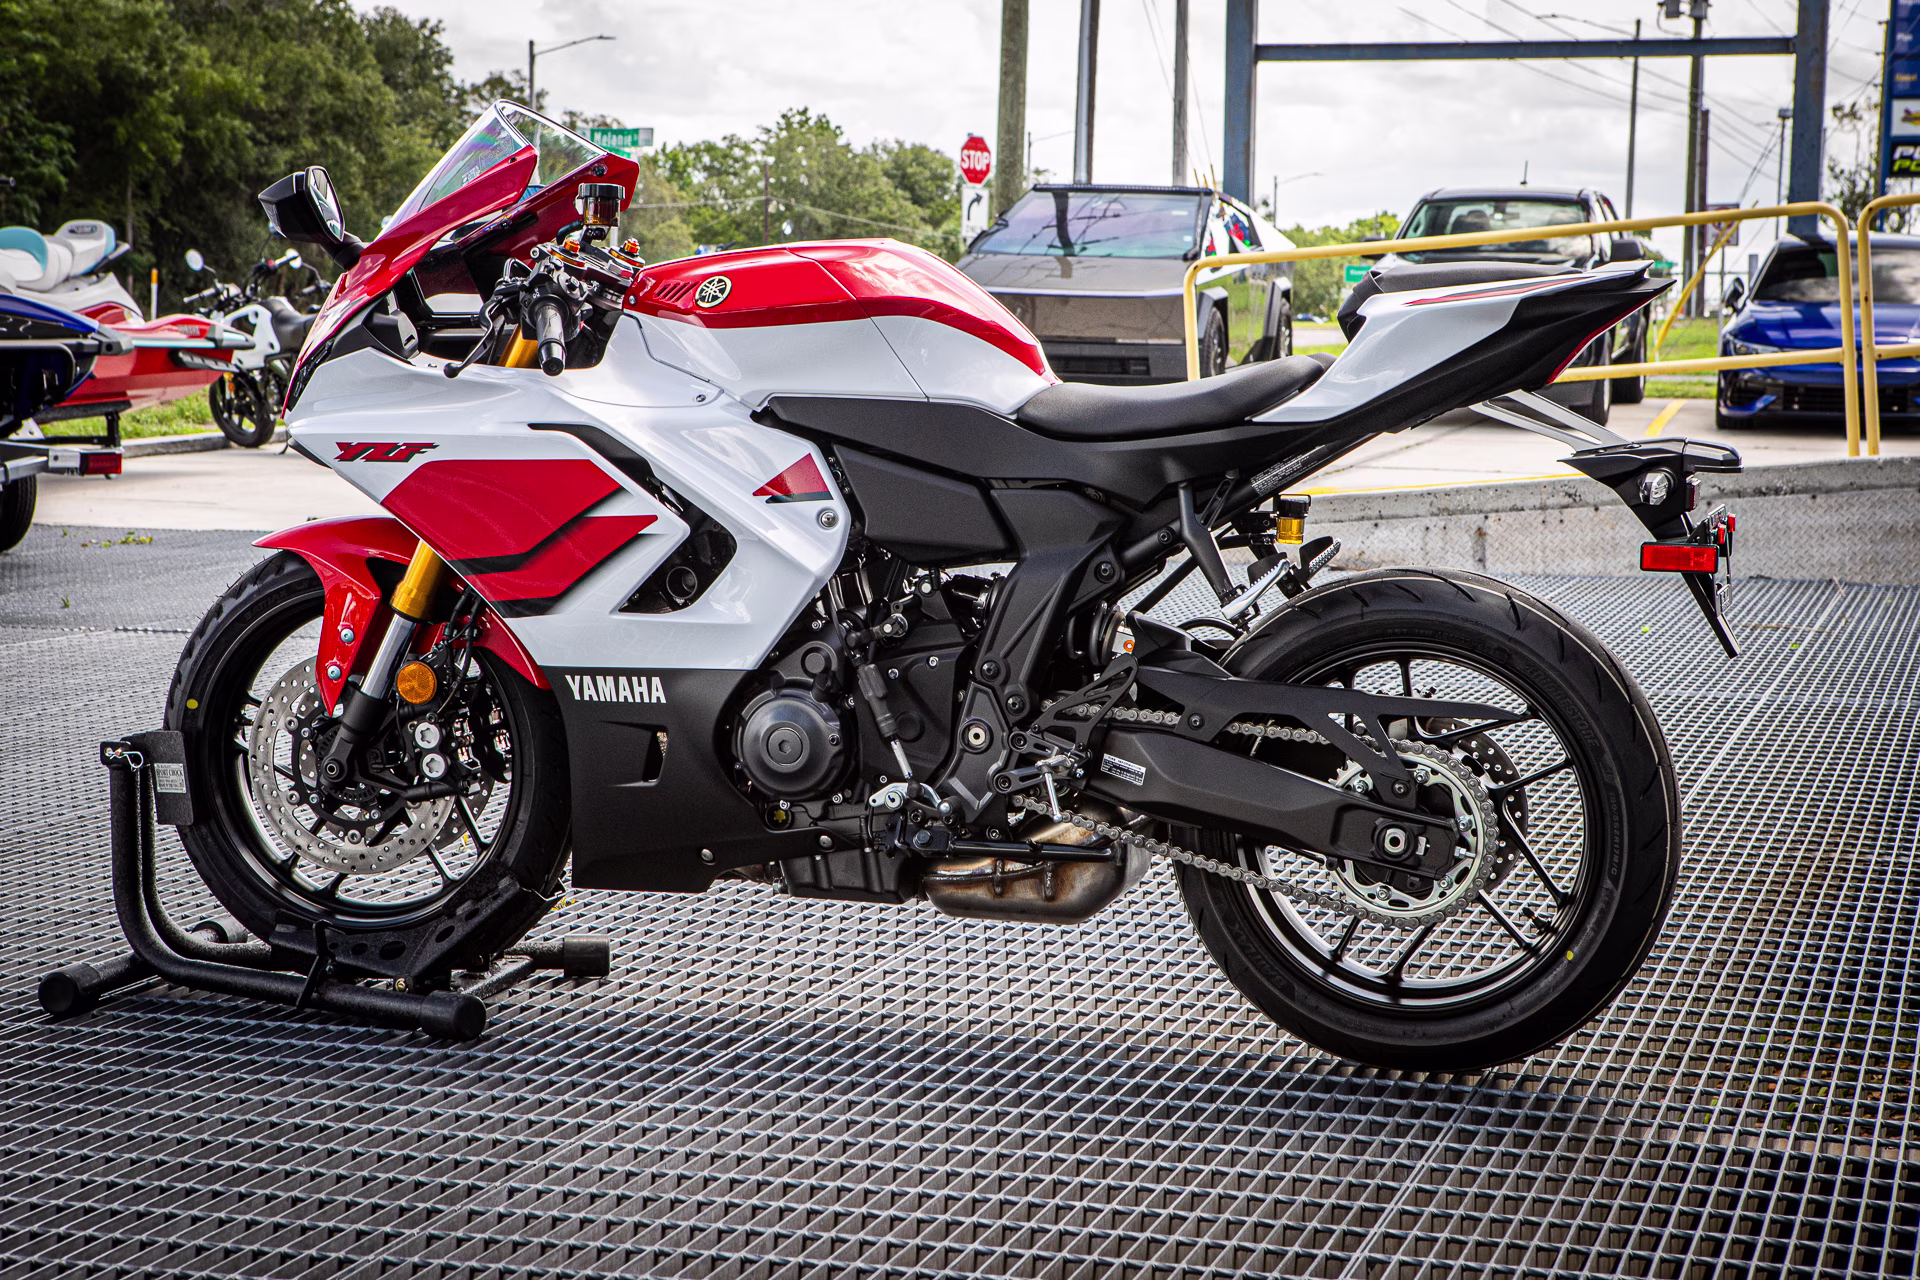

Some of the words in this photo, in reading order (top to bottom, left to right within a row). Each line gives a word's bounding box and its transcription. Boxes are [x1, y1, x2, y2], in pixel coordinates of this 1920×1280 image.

[594, 131, 632, 147] Melanie
[961, 150, 990, 171] STOP
[565, 675, 667, 704] YAMAHA
